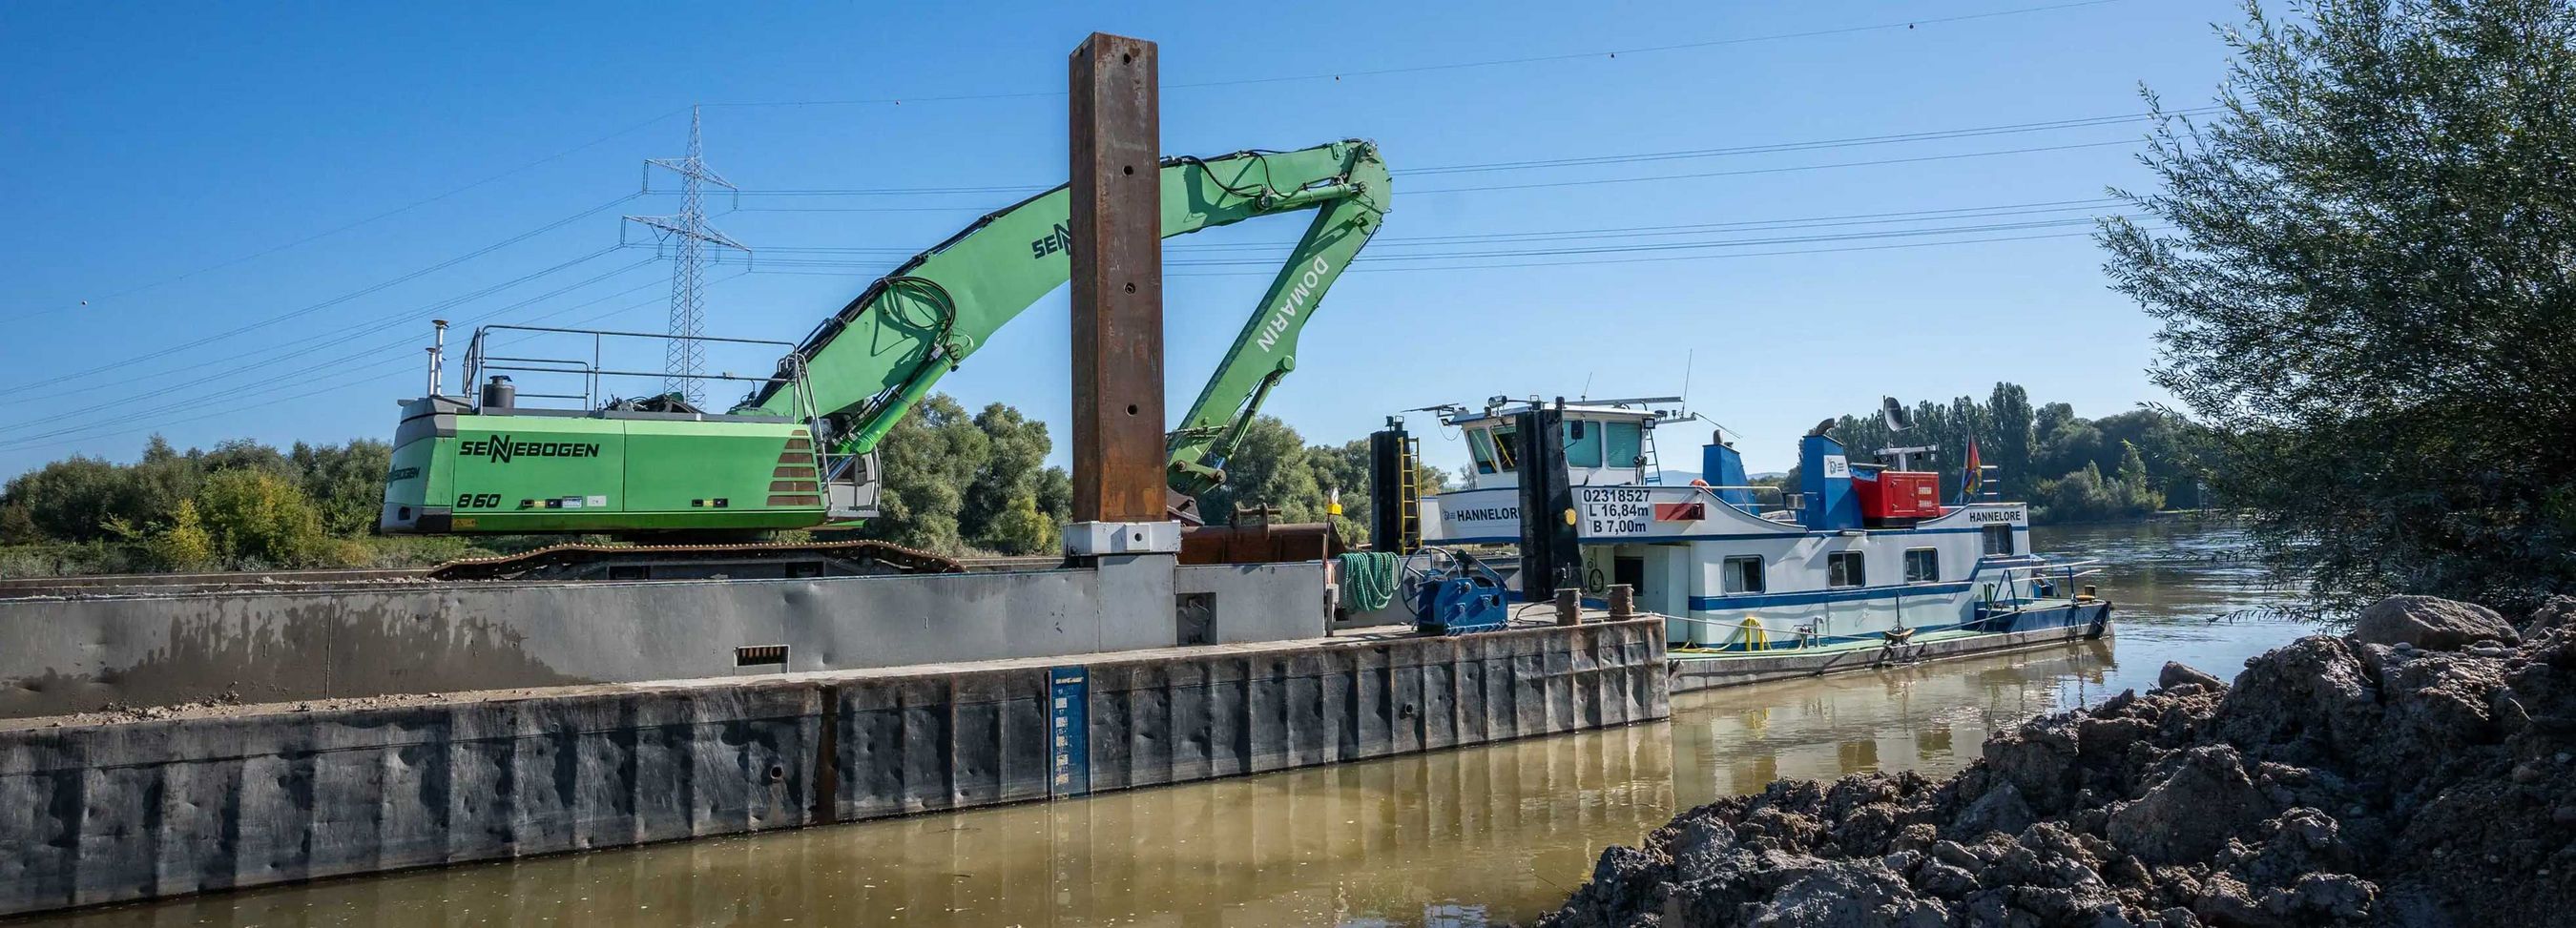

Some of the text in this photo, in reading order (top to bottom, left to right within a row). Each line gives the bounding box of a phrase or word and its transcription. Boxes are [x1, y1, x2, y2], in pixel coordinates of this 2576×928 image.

[1257, 256, 1329, 353] DOMARIN
[459, 434, 600, 464] SENNEBOGEN
[456, 493, 501, 508] 860
[1583, 489, 1652, 503] 02318527
[1456, 506, 1521, 522] HANNELOR
[1589, 504, 1649, 519] L 16,84m
[1969, 510, 2021, 523] HANNELORE
[1593, 520, 1647, 534] B 7,00m
